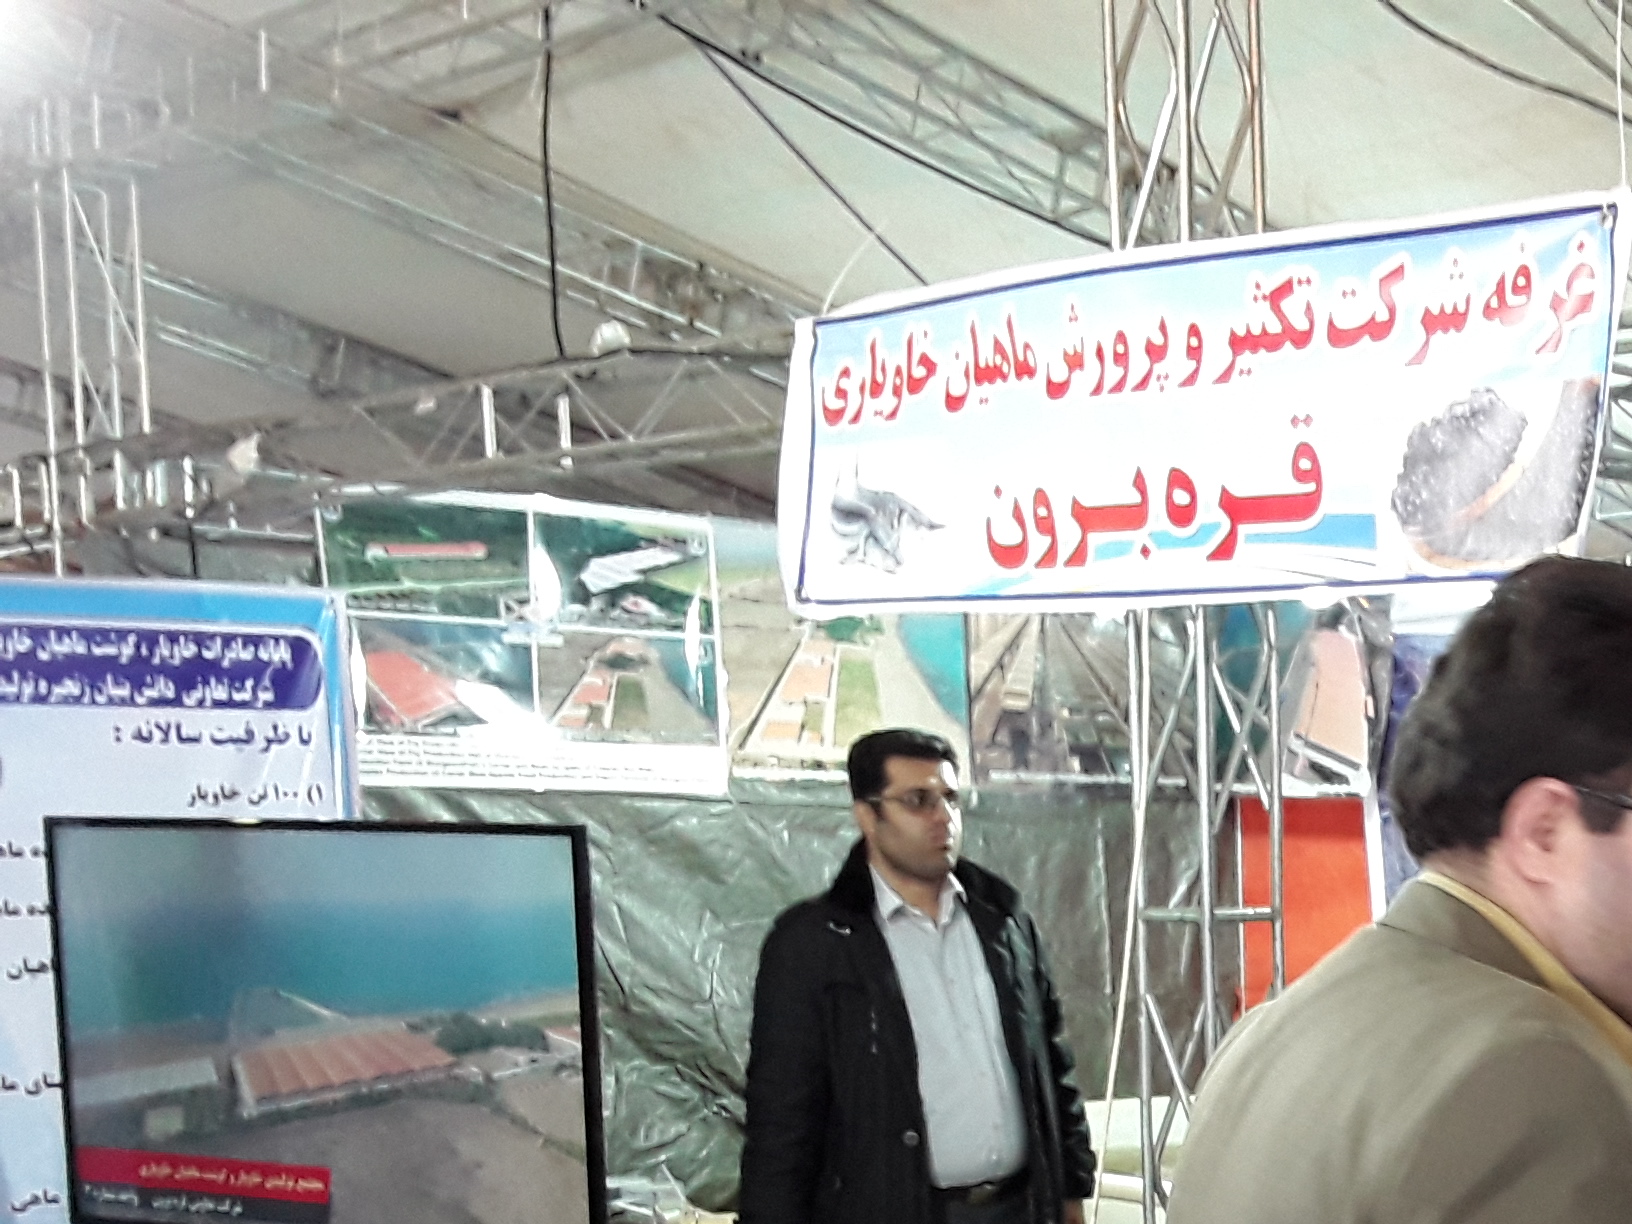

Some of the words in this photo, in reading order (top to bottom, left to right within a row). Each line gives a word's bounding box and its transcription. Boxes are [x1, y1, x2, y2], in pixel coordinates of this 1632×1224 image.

[1211, 274, 1316, 385] تکثیر
[1326, 257, 1472, 367] شرکت
[1482, 239, 1596, 356] غرفه
[821, 329, 939, 427] خاویاری
[944, 312, 1038, 414] ماهیان
[1046, 302, 1169, 400] پرورش
[1177, 322, 1204, 388] و
[985, 465, 1152, 570] برون
[1164, 413, 1323, 562] قره
[130, 719, 202, 745] سالانه
[209, 720, 291, 754] ظرفیت
[297, 724, 313, 746] با
[186, 783, 241, 808] خاویار
